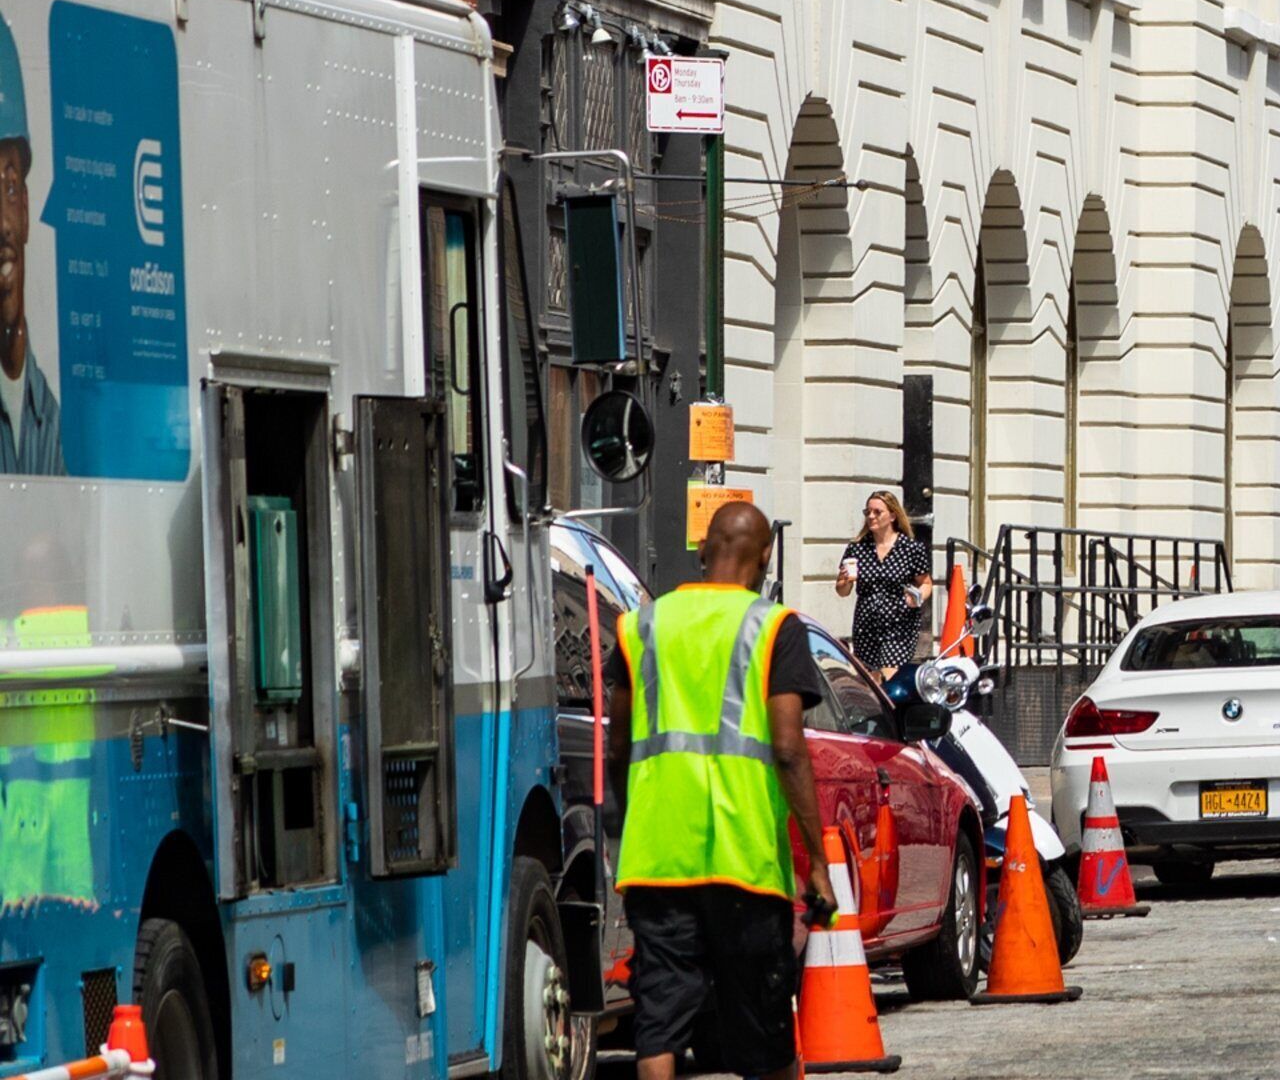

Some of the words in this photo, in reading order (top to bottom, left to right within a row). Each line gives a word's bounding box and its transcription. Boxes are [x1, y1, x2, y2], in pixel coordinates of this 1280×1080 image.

[674, 68, 697, 77] Monday
[674, 78, 701, 87] Thursday
[130, 261, 175, 296] conEdison
